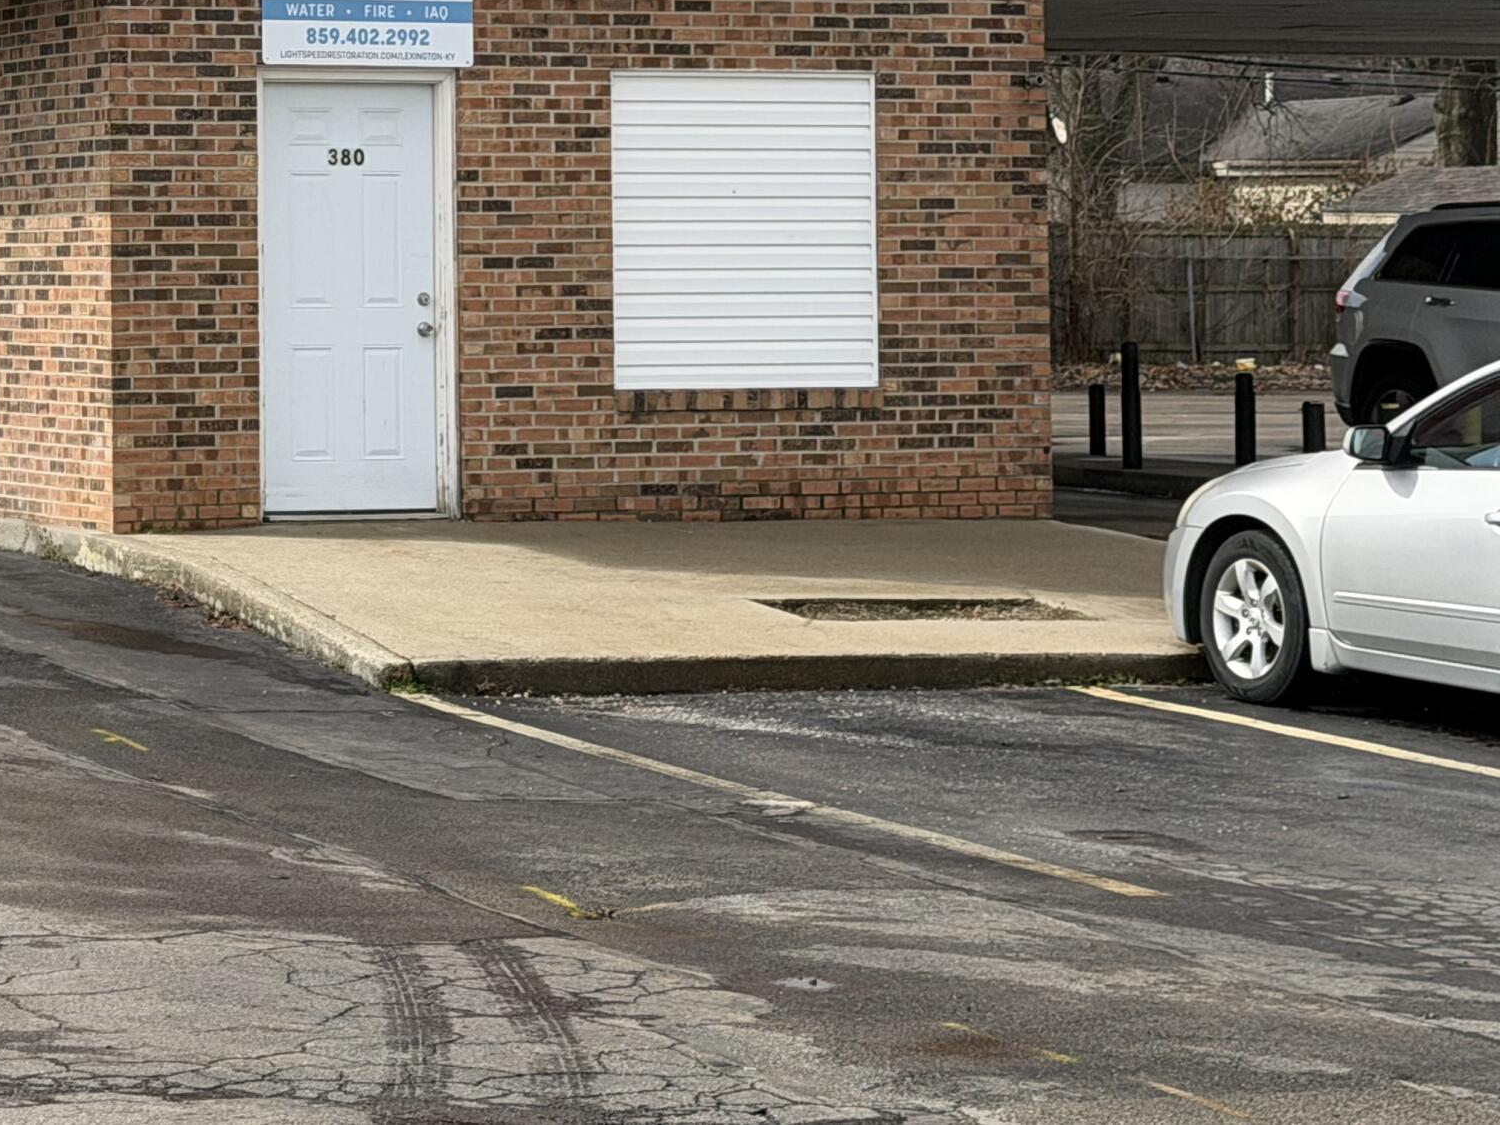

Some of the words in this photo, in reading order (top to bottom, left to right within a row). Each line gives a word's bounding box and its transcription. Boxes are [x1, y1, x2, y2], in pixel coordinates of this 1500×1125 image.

[286, 3, 335, 17] WATER
[364, 4, 396, 18] FIRE
[425, 6, 449, 21] IAQ
[306, 28, 430, 46] 859.402.2992
[328, 148, 365, 166] 380
